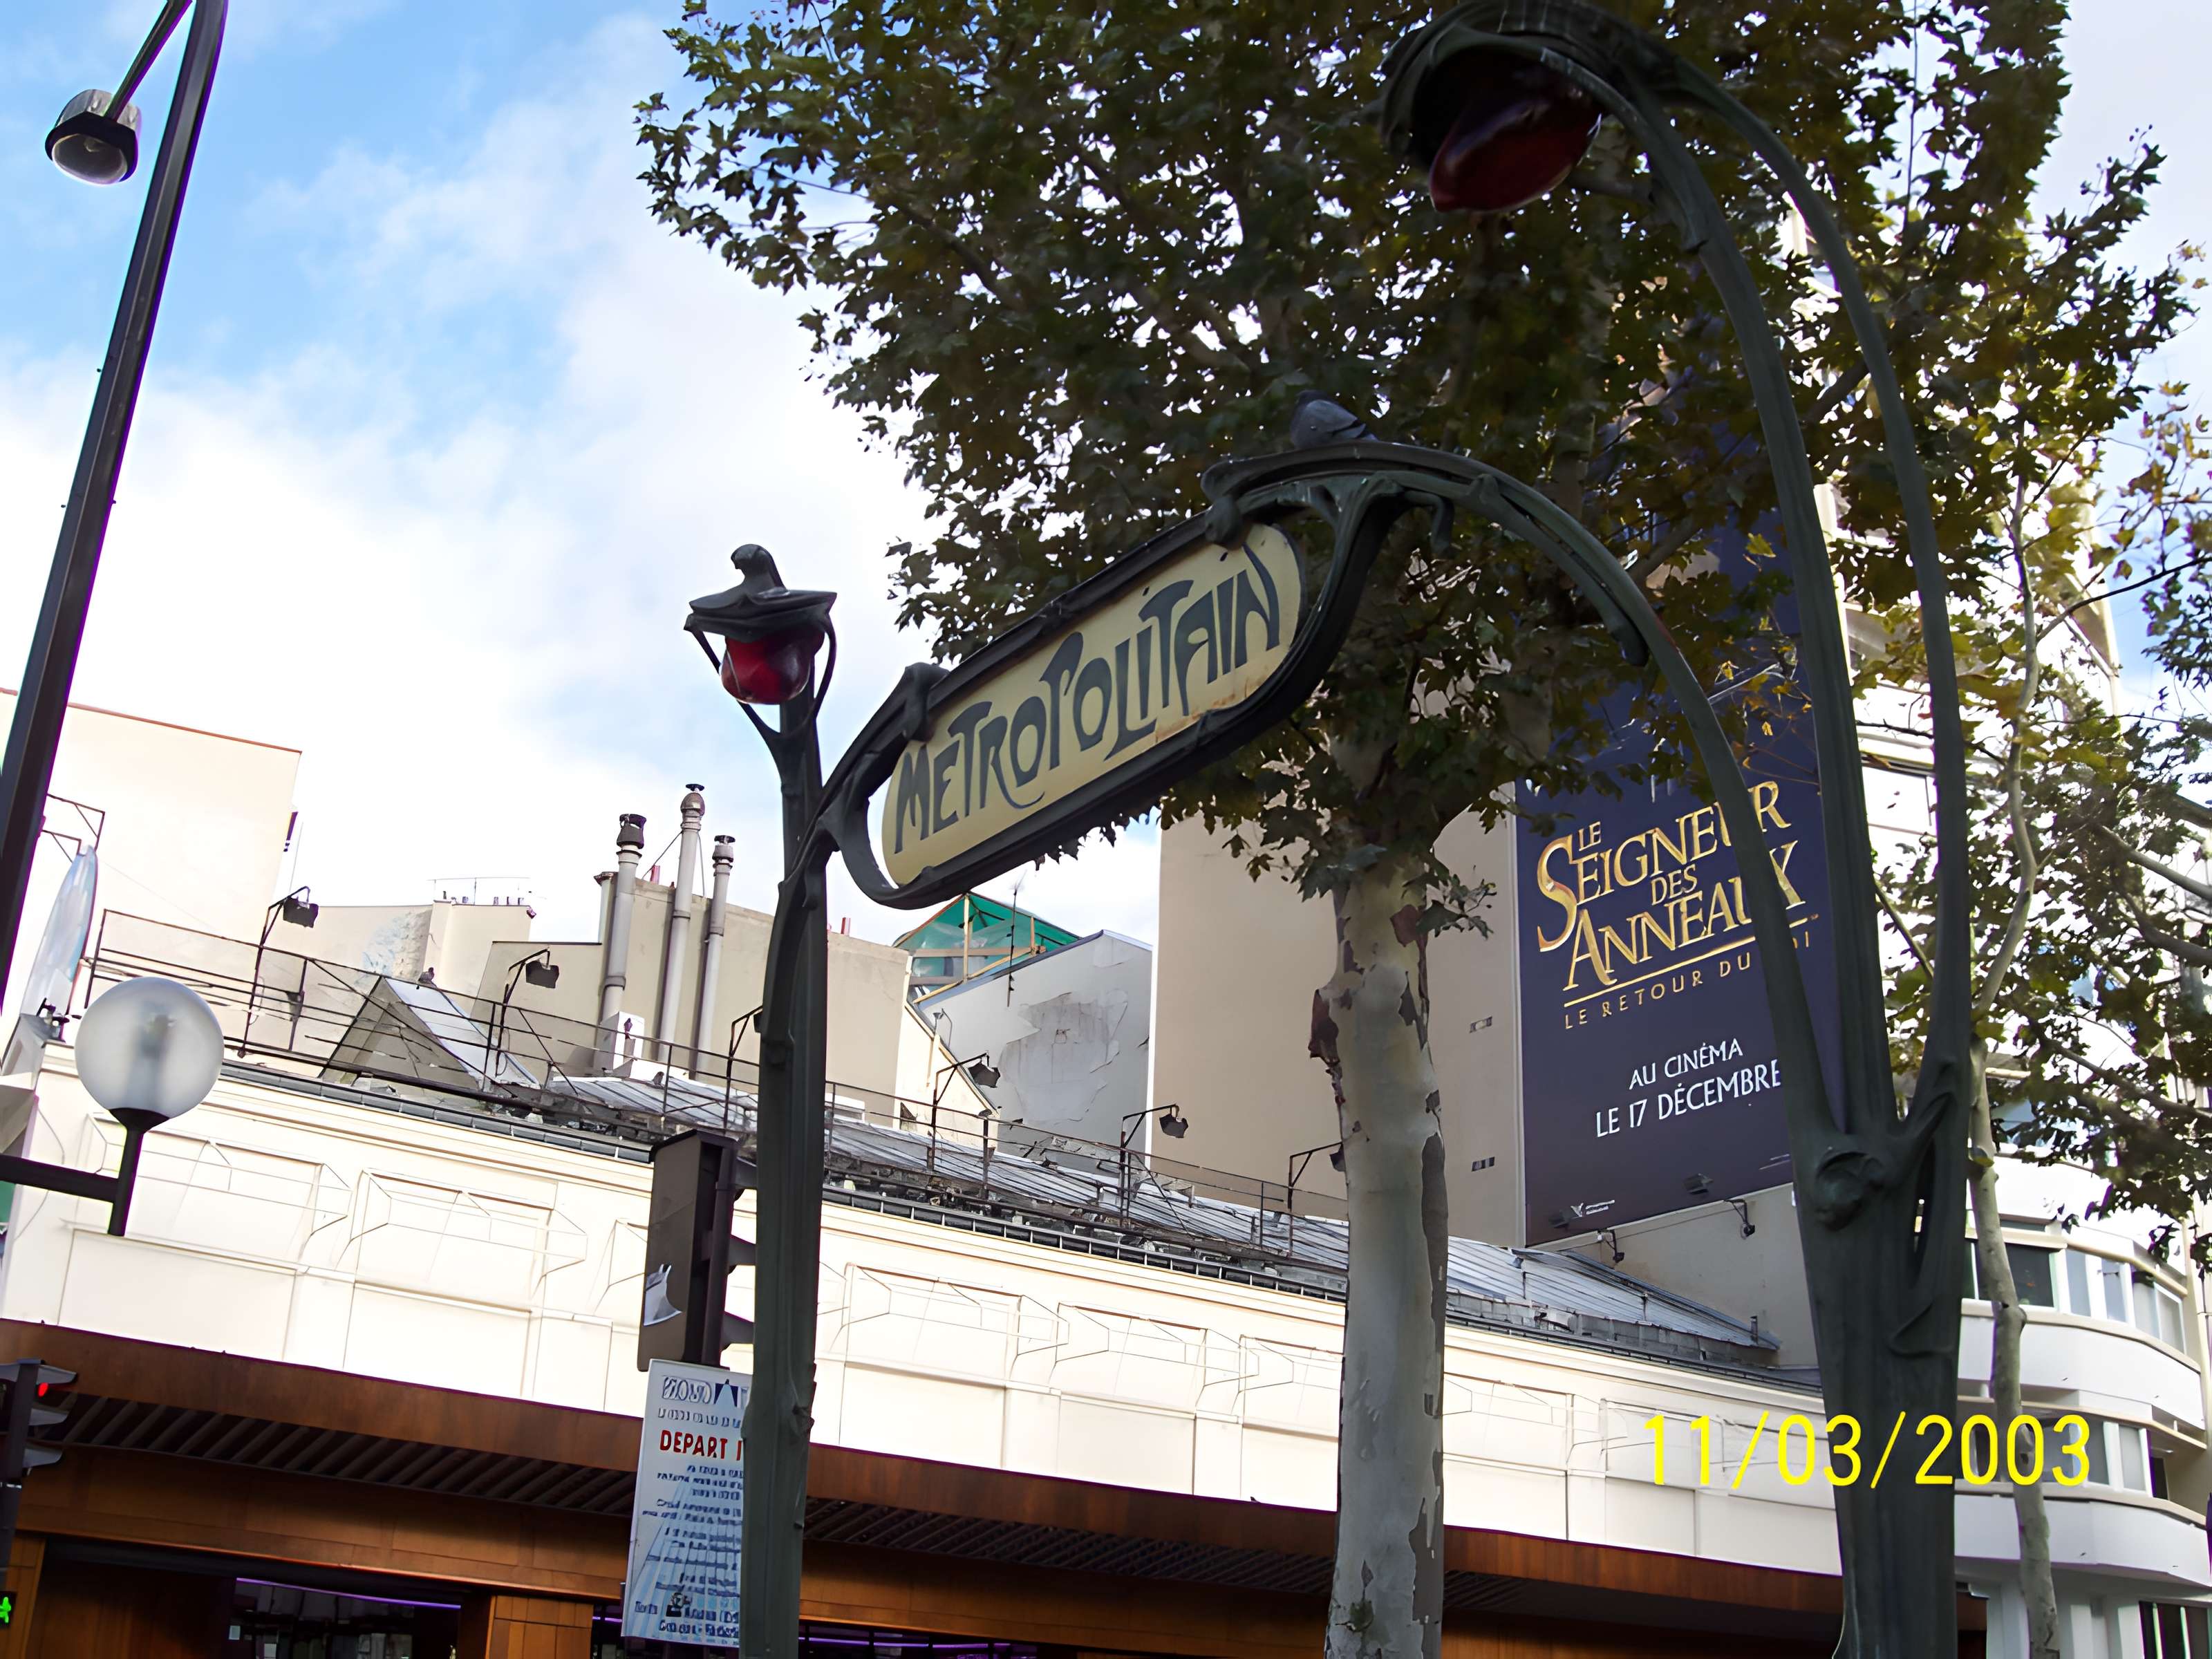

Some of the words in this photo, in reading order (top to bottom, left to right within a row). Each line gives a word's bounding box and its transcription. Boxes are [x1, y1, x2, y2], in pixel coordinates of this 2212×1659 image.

[894, 544, 1280, 854] METROPOLITAIN
[1577, 821, 1602, 852] LE
[1650, 863, 1698, 906] DES
[1564, 1009, 1588, 1029] LE
[1602, 969, 1703, 1018] RETOUR
[1719, 951, 1752, 977] DU
[1629, 1062, 1656, 1089] AU
[1665, 1038, 1743, 1077] CINÉMA
[1596, 1107, 1620, 1138] LE
[1629, 1099, 1648, 1128] 17
[1658, 1059, 1782, 1121] DÉCEMBRE
[659, 1429, 729, 1459] DEPART
